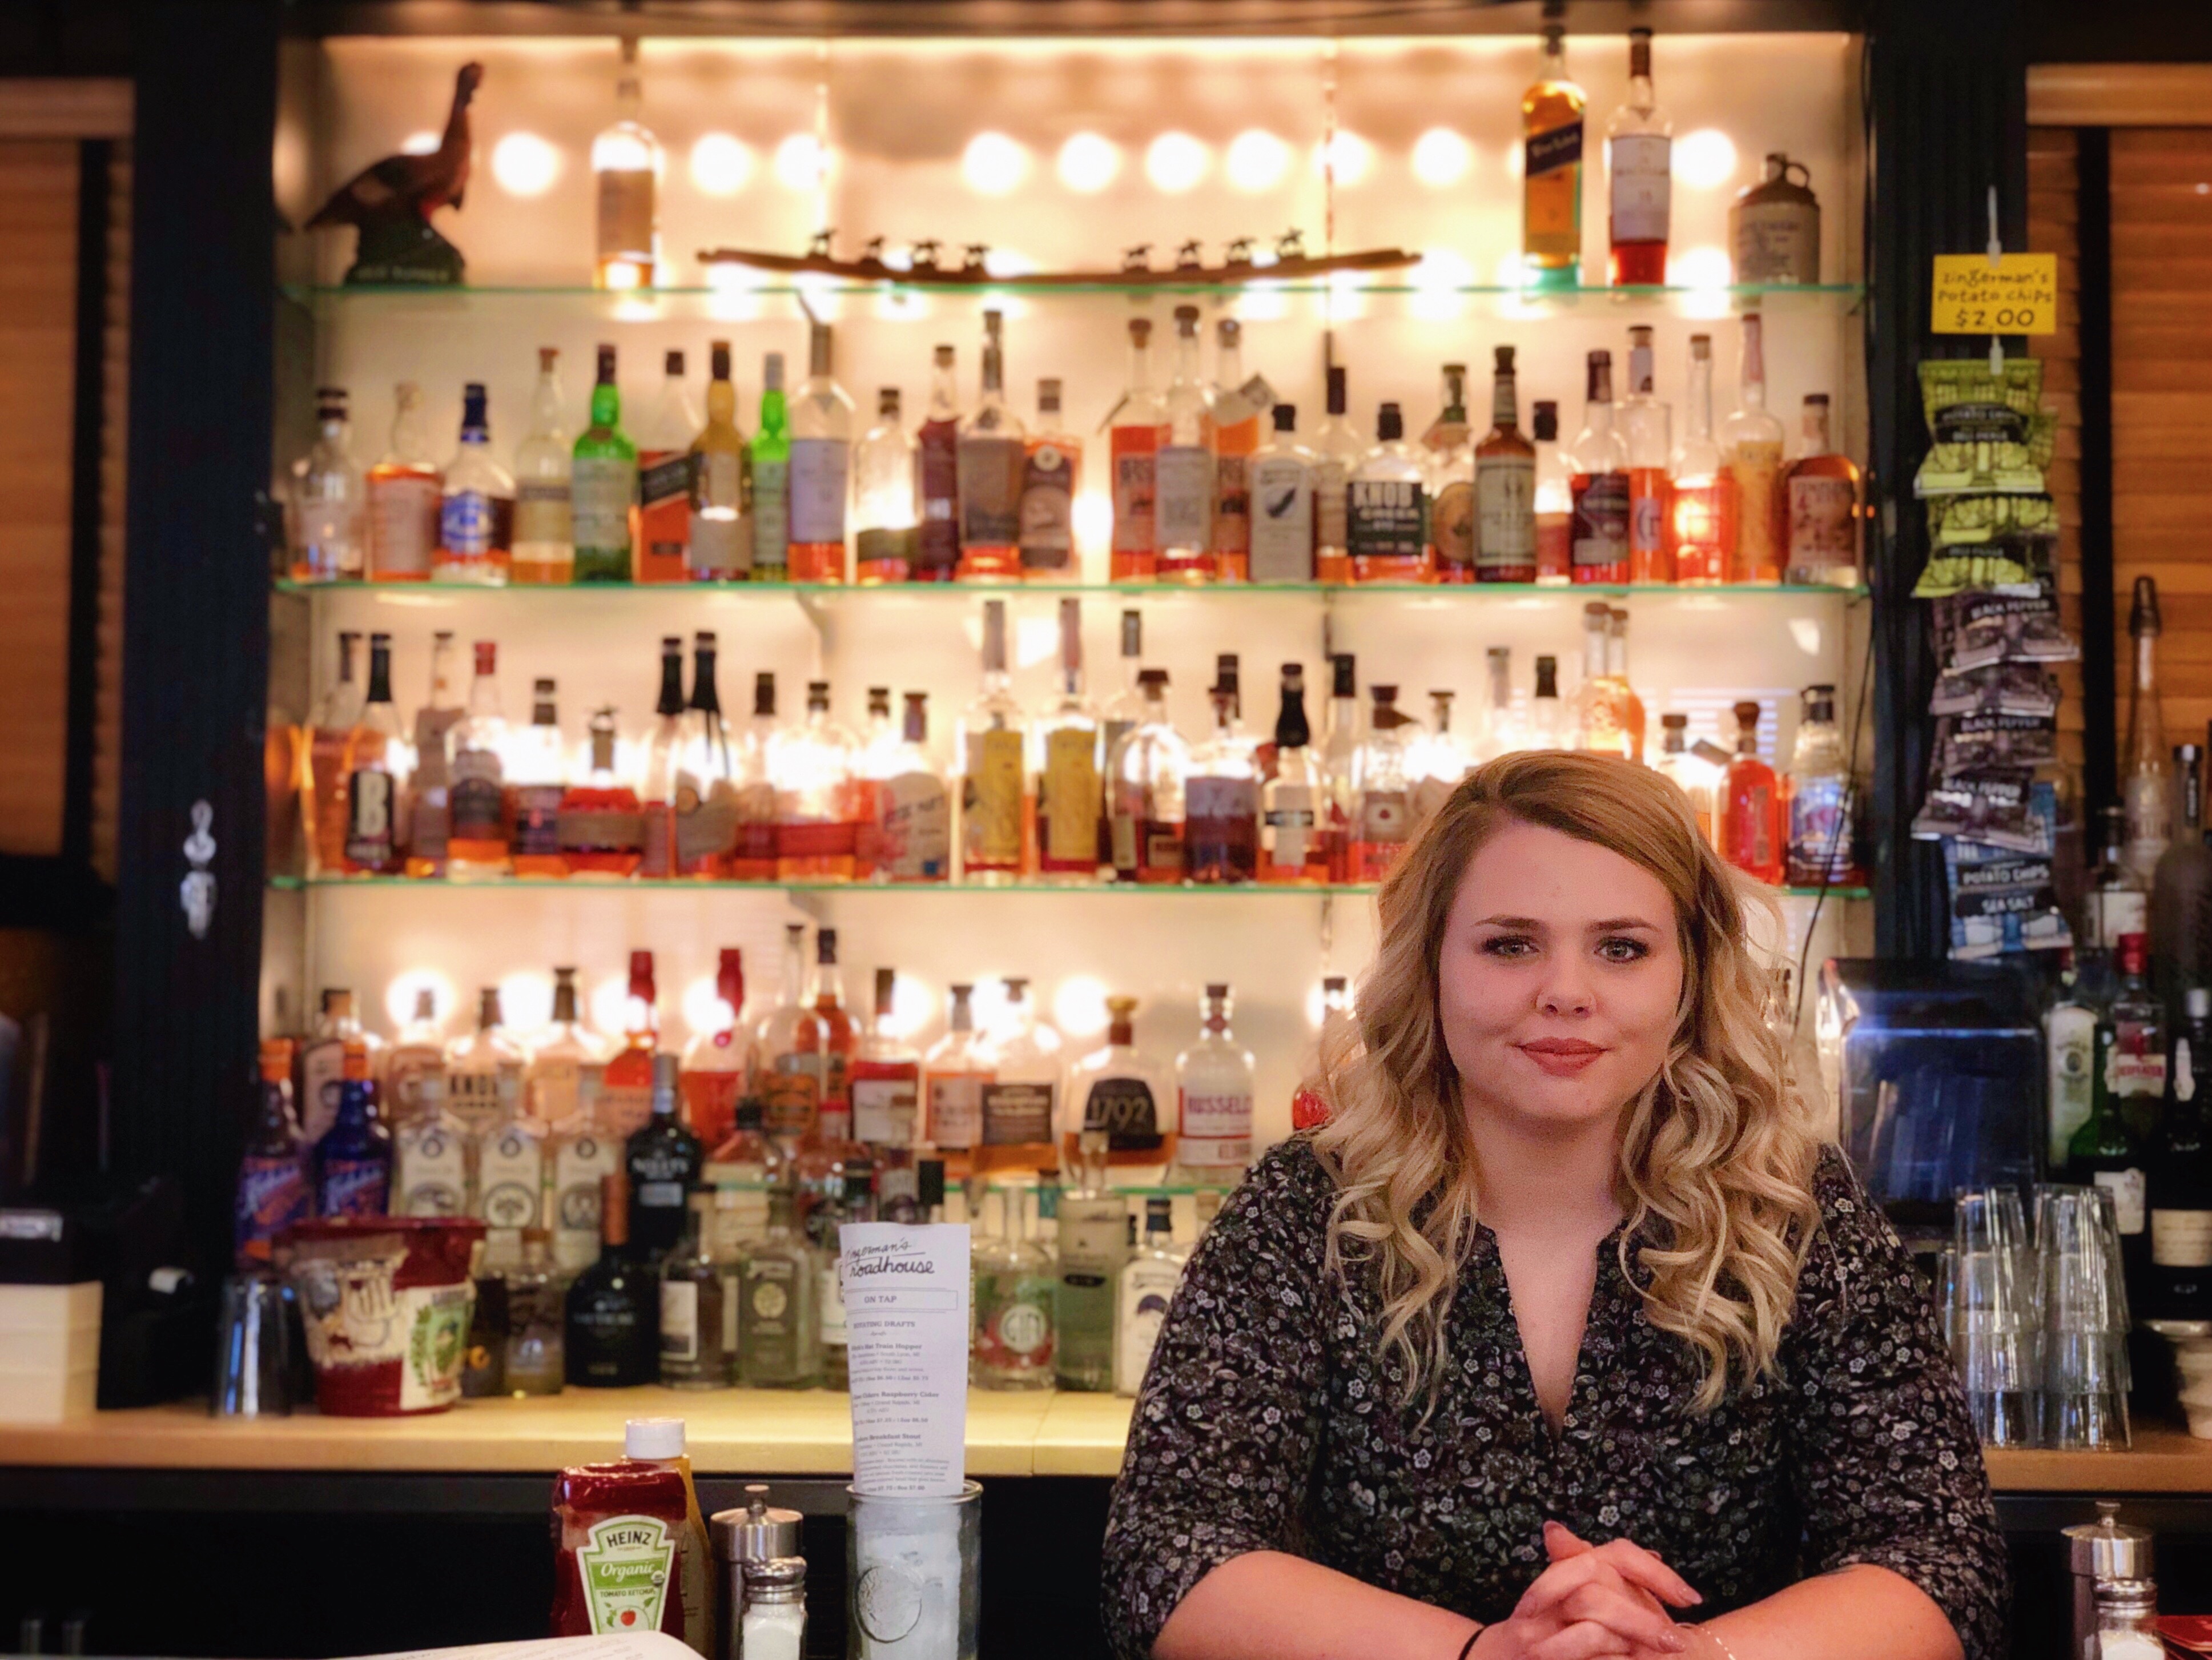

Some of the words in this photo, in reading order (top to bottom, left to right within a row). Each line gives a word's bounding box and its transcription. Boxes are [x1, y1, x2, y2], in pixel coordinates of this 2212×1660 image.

[1955, 308, 2034, 331] $2.00
[1981, 898, 2006, 914] SEA
[1089, 1097, 1149, 1132] 1792
[606, 1529, 651, 1548] HEINZ
[601, 1562, 655, 1582] Organic
[628, 1588, 654, 1597] KETCHUP
